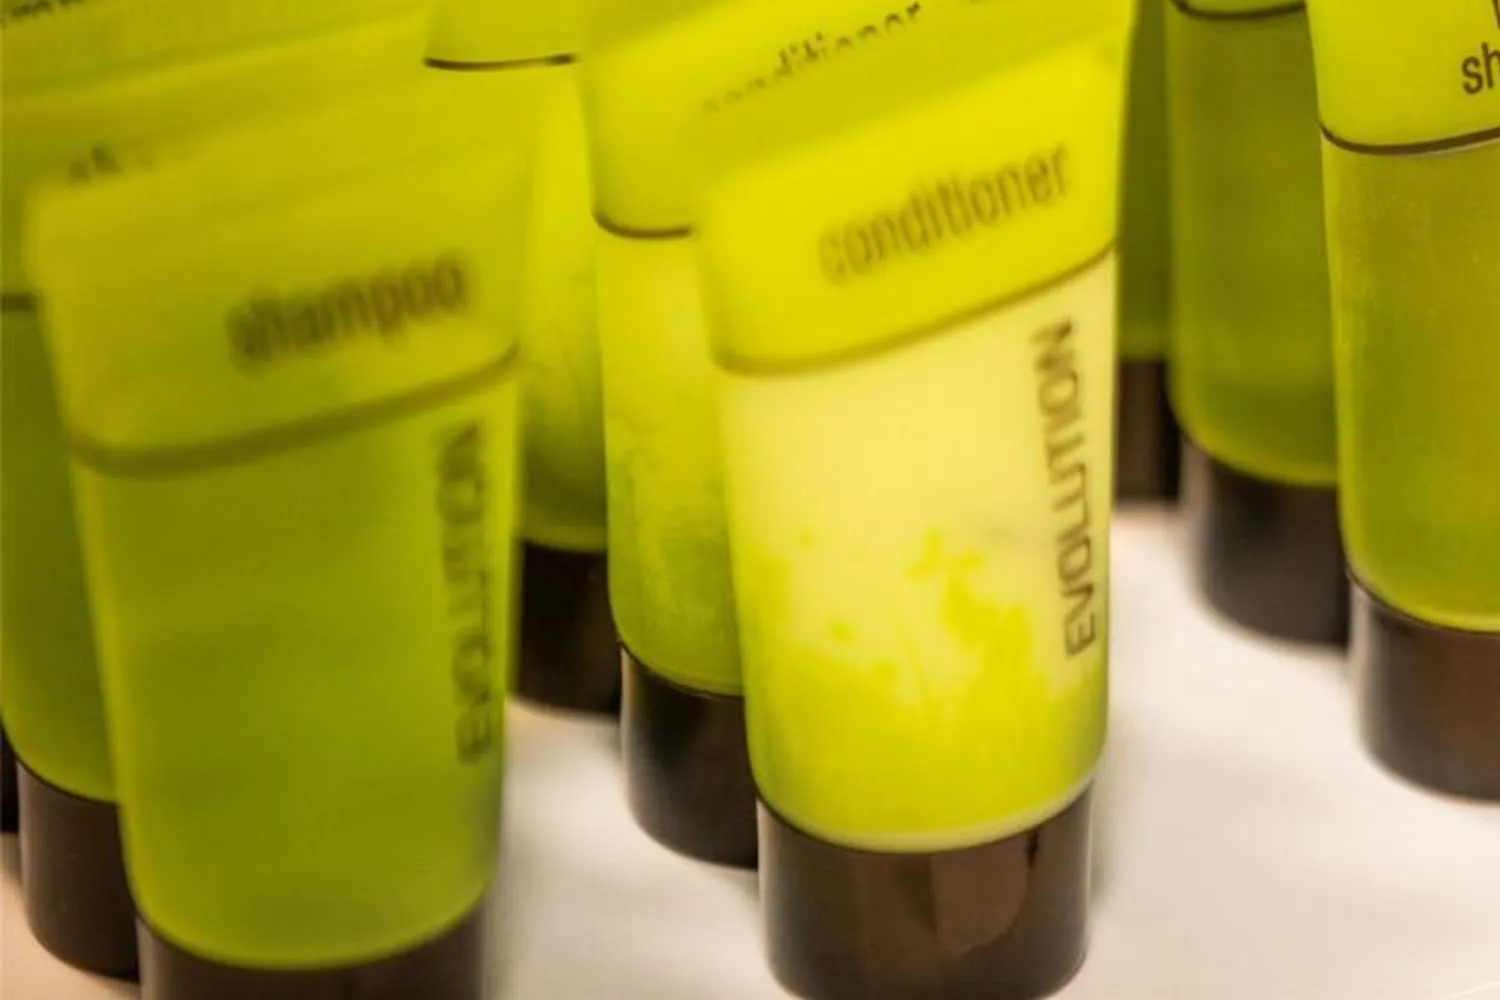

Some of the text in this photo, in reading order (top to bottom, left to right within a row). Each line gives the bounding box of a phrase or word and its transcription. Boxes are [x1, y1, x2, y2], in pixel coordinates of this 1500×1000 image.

[818, 143, 1070, 286] conditioner
[226, 252, 472, 370] shampoo
[1028, 314, 1098, 660] EVOLUTION
